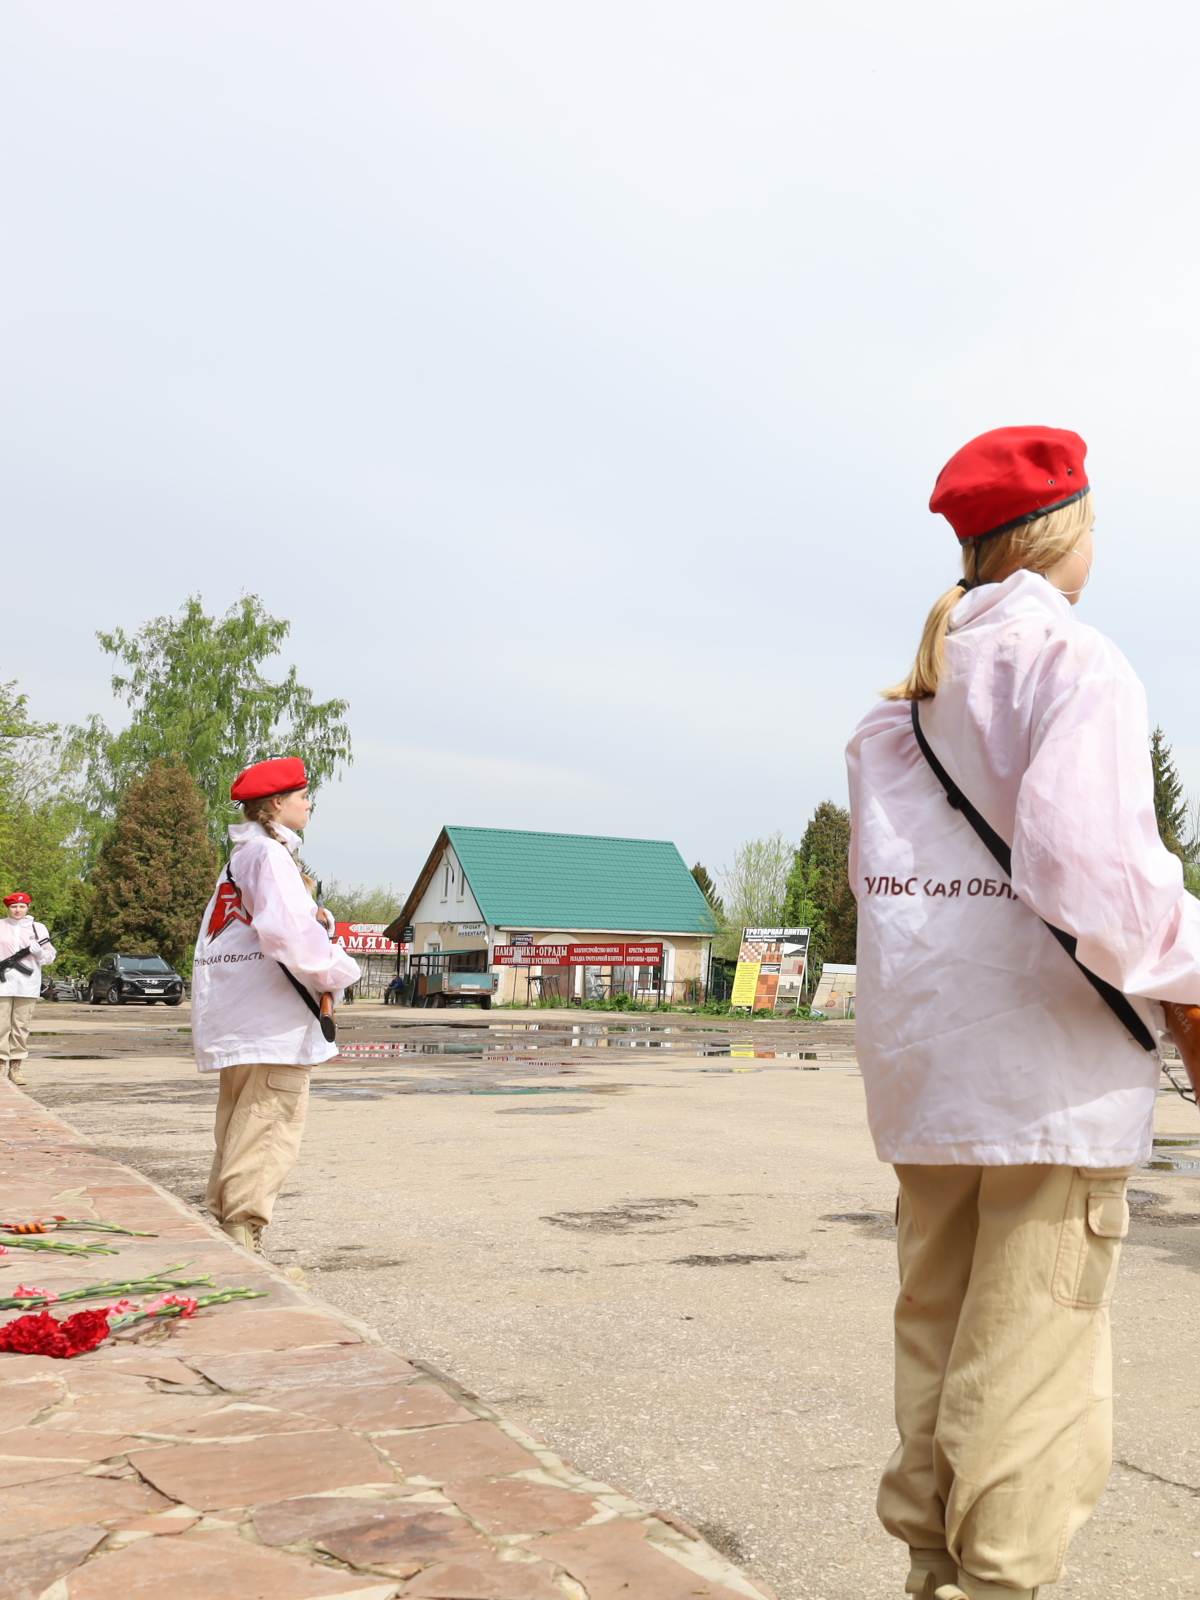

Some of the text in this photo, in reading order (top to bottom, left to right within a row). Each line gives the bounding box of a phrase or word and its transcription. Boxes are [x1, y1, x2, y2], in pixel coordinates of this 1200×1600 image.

[864, 876, 962, 898] УЛЬСКАЯ
[194, 951, 265, 968] ТУЛЬСКАЯ ОБЛАСТЬ
[539, 946, 568, 959] ОГРАДЫ
